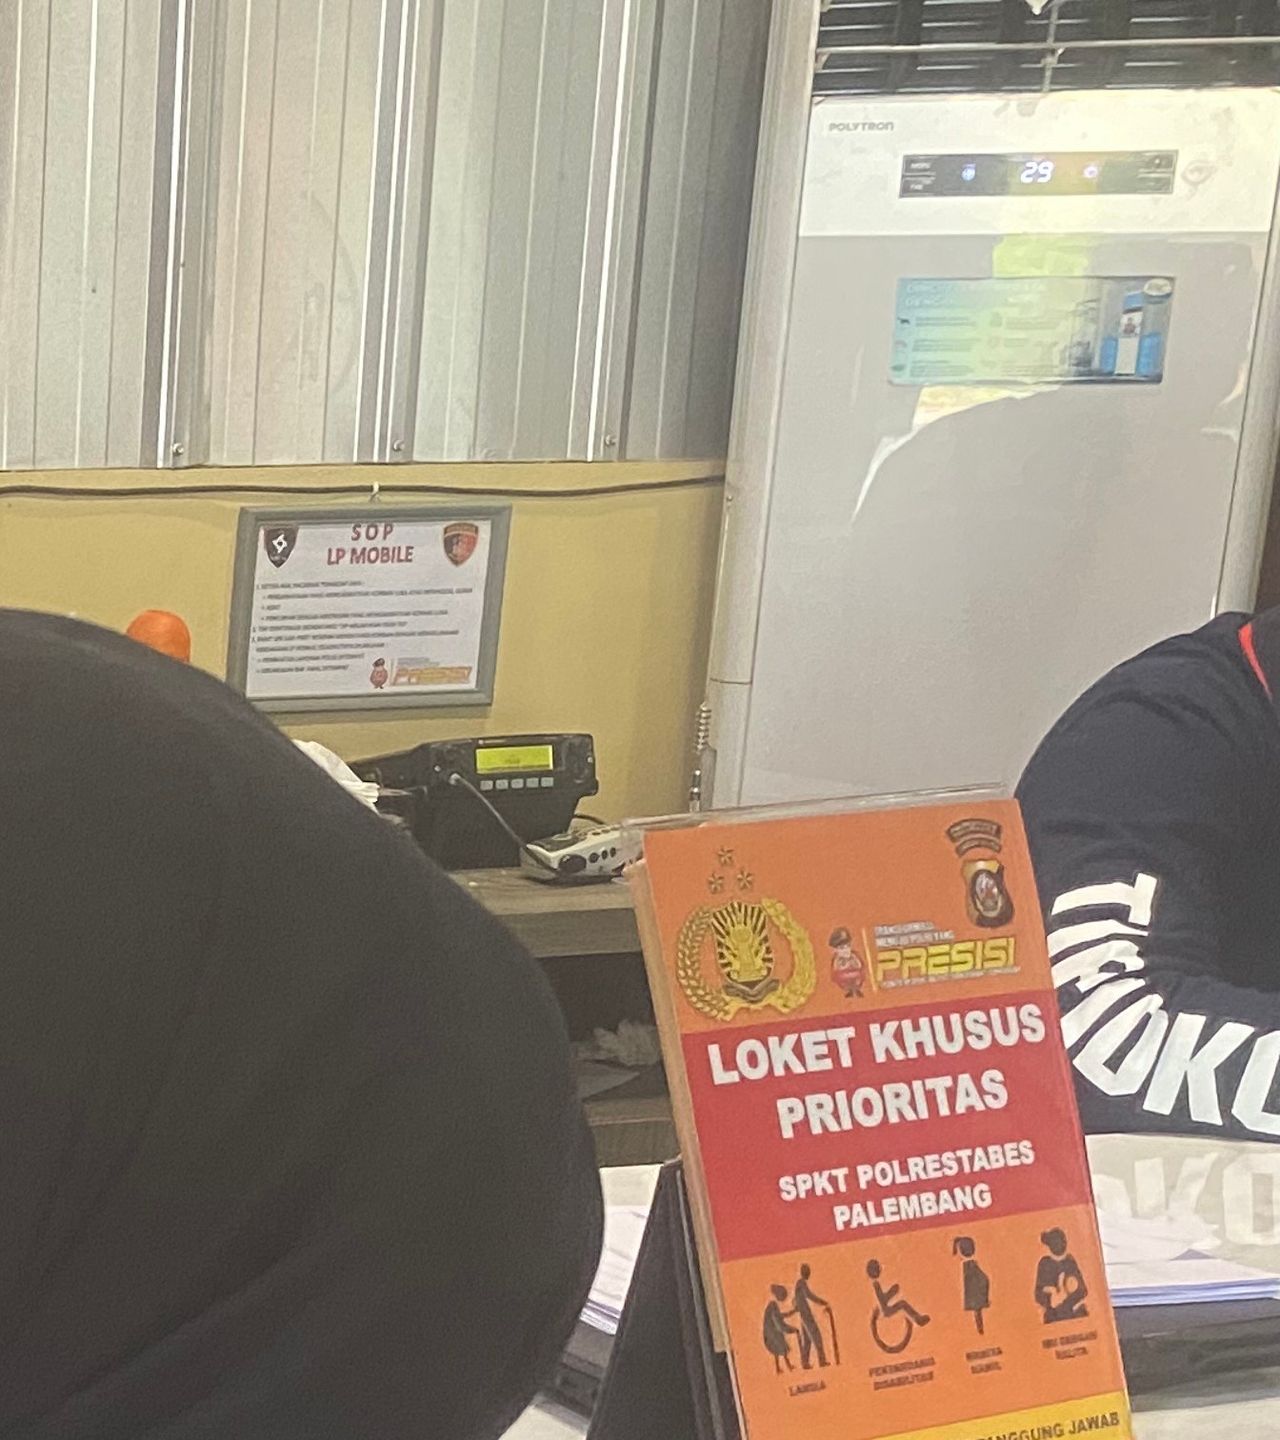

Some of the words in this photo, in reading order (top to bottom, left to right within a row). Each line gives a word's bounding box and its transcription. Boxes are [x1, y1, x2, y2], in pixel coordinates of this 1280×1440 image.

[828, 121, 895, 132] POLYTRON
[1020, 161, 1055, 184] 29
[327, 548, 346, 566] LP
[350, 546, 415, 565] MOBILE
[876, 936, 1016, 983] PRESISI
[707, 1026, 856, 1086] LOKET
[869, 1003, 1046, 1064] KHUSUS
[776, 1068, 1009, 1140] PRIORITAS
[778, 1167, 849, 1202] SPKT
[856, 1139, 1036, 1190] POLRESTABES
[832, 1182, 993, 1231] PALEMBANG
[1068, 1411, 1121, 1435] JAWAB
